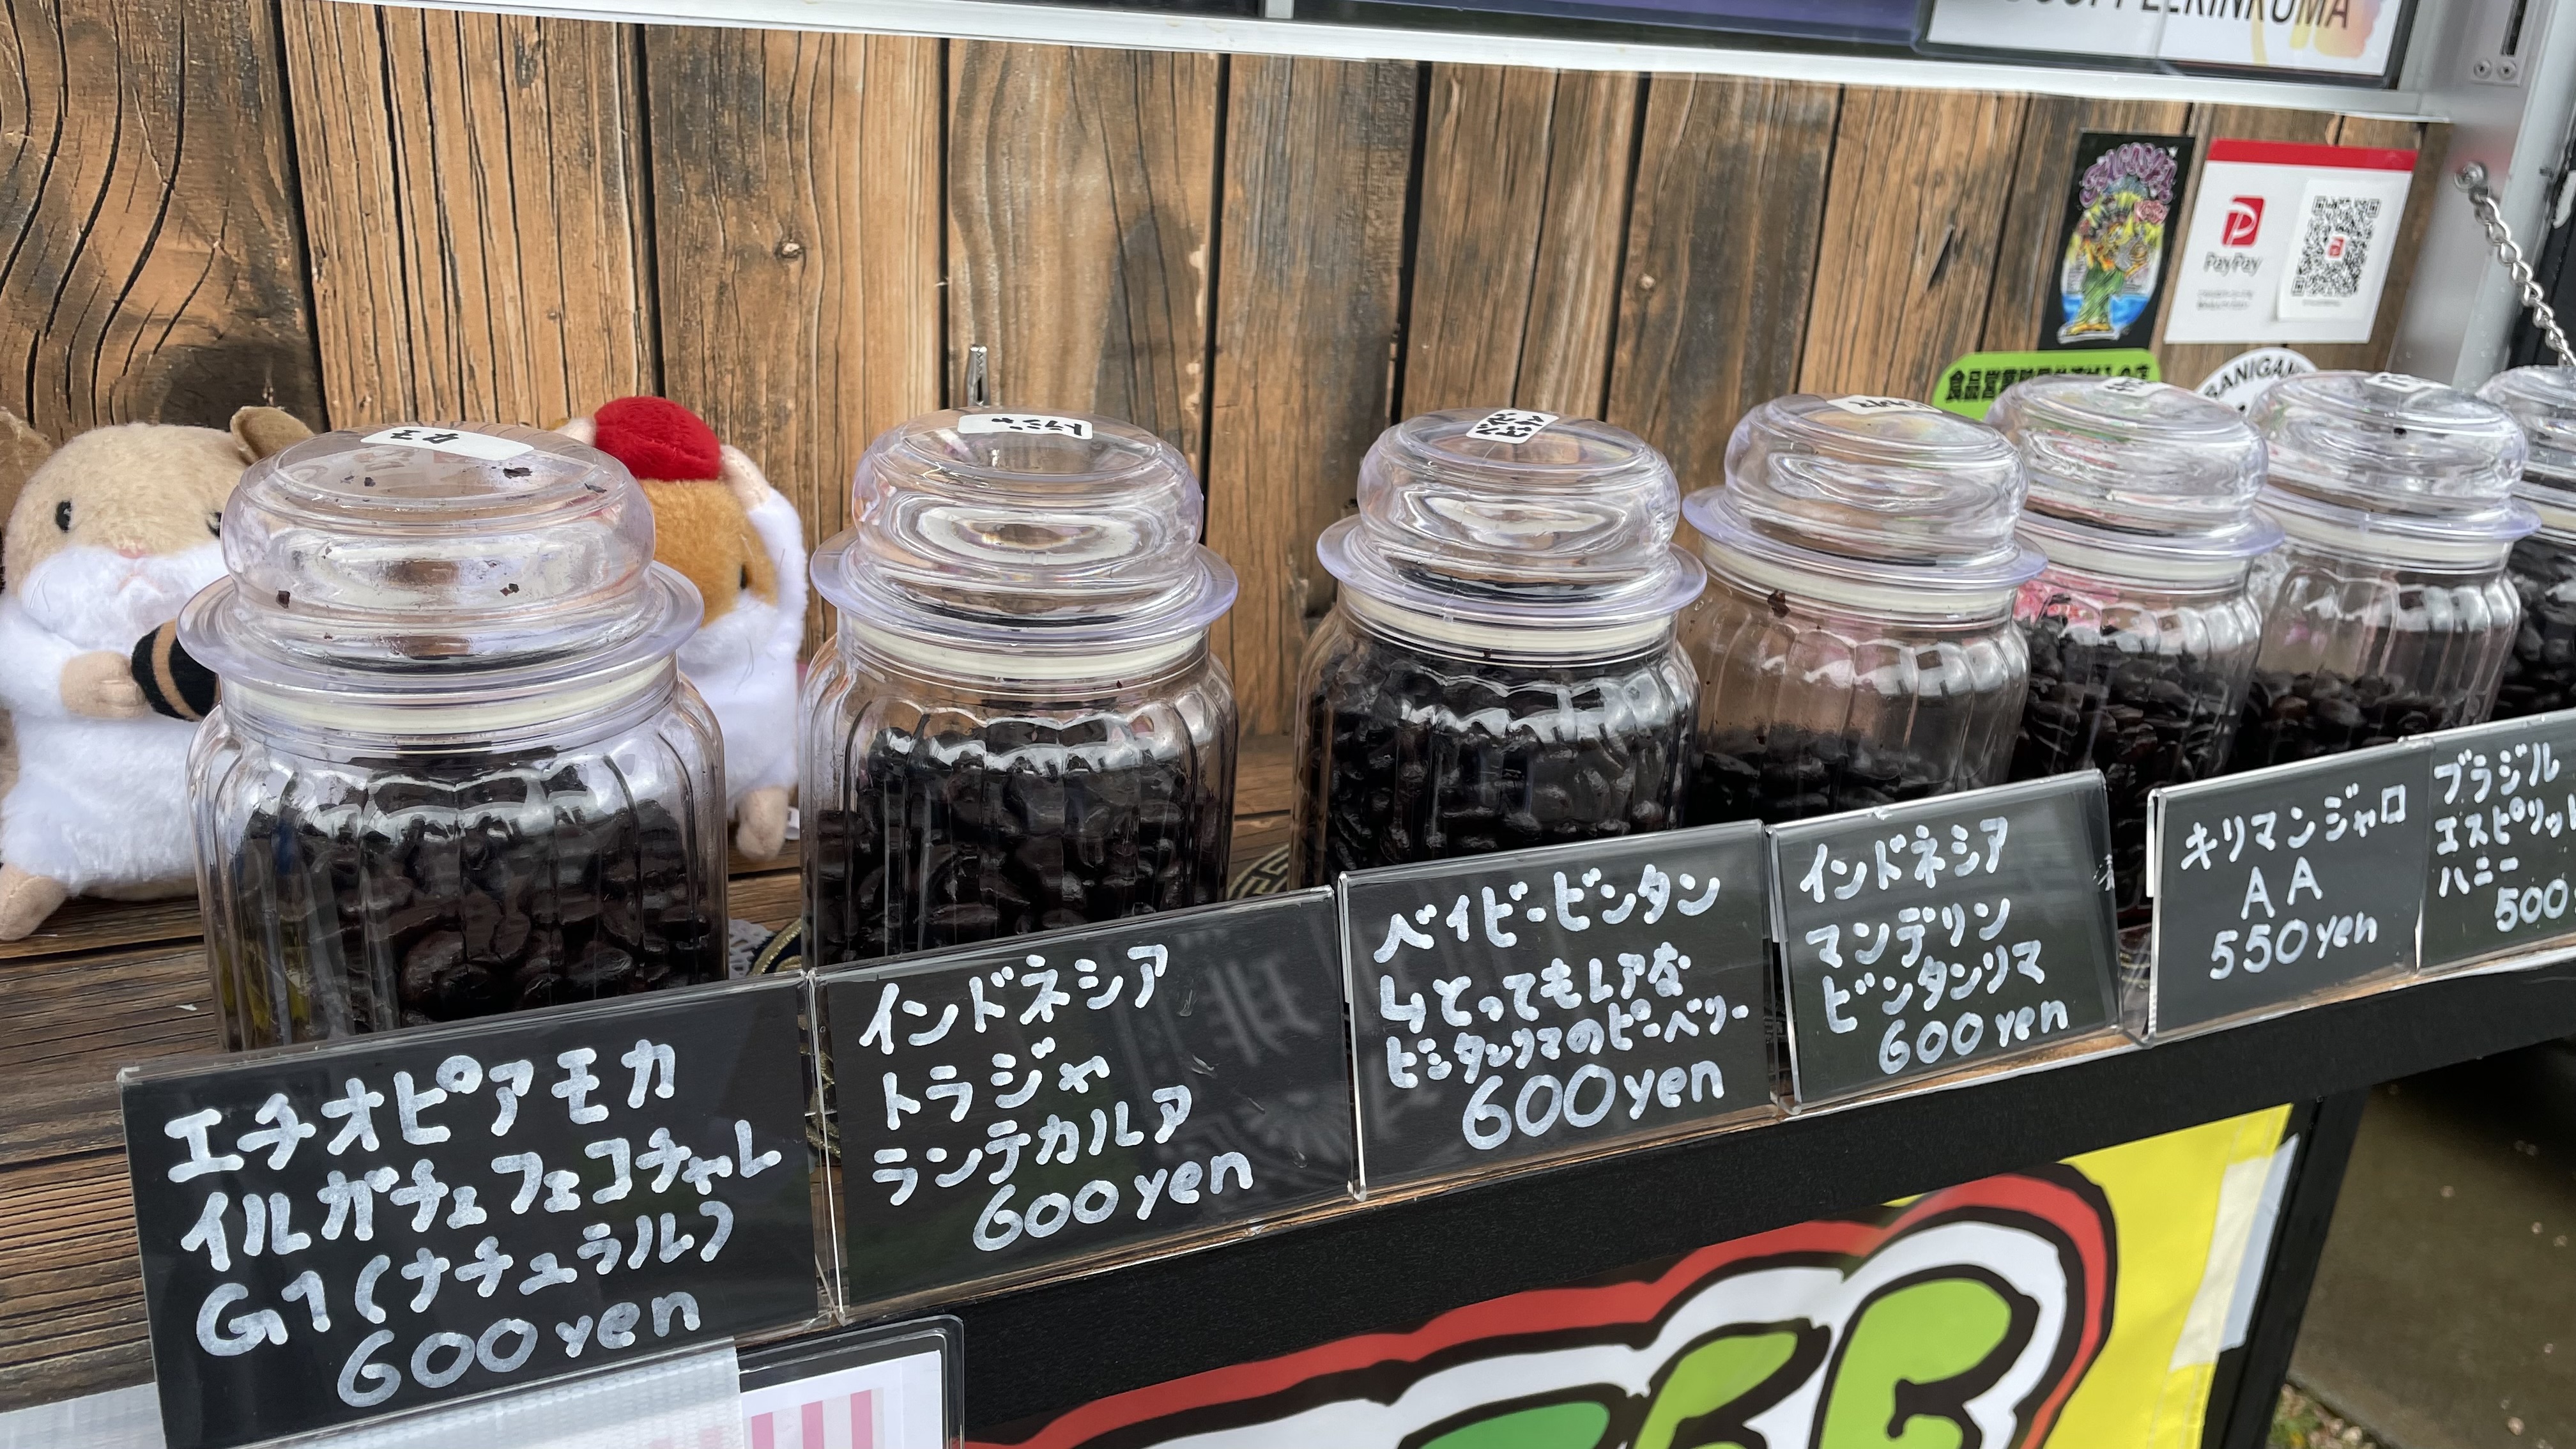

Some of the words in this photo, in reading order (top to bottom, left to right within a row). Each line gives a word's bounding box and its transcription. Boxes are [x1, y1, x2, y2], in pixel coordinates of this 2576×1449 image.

[2204, 252, 2264, 277] PayPay
[2434, 742, 2559, 804] ブラジル
[1800, 816, 2008, 903] インドネシア
[2181, 783, 2405, 870] キリマンジャロ
[1374, 864, 1721, 963] ベイビービンタン
[2439, 857, 2518, 897] ハニー
[1805, 898, 2011, 968] マンデリン
[859, 944, 1168, 1054] インドネシア
[1823, 940, 2044, 1033] ビンタンリマ
[883, 1037, 1110, 1130] トラジャ
[873, 1085, 1192, 1206] ランテカルア
